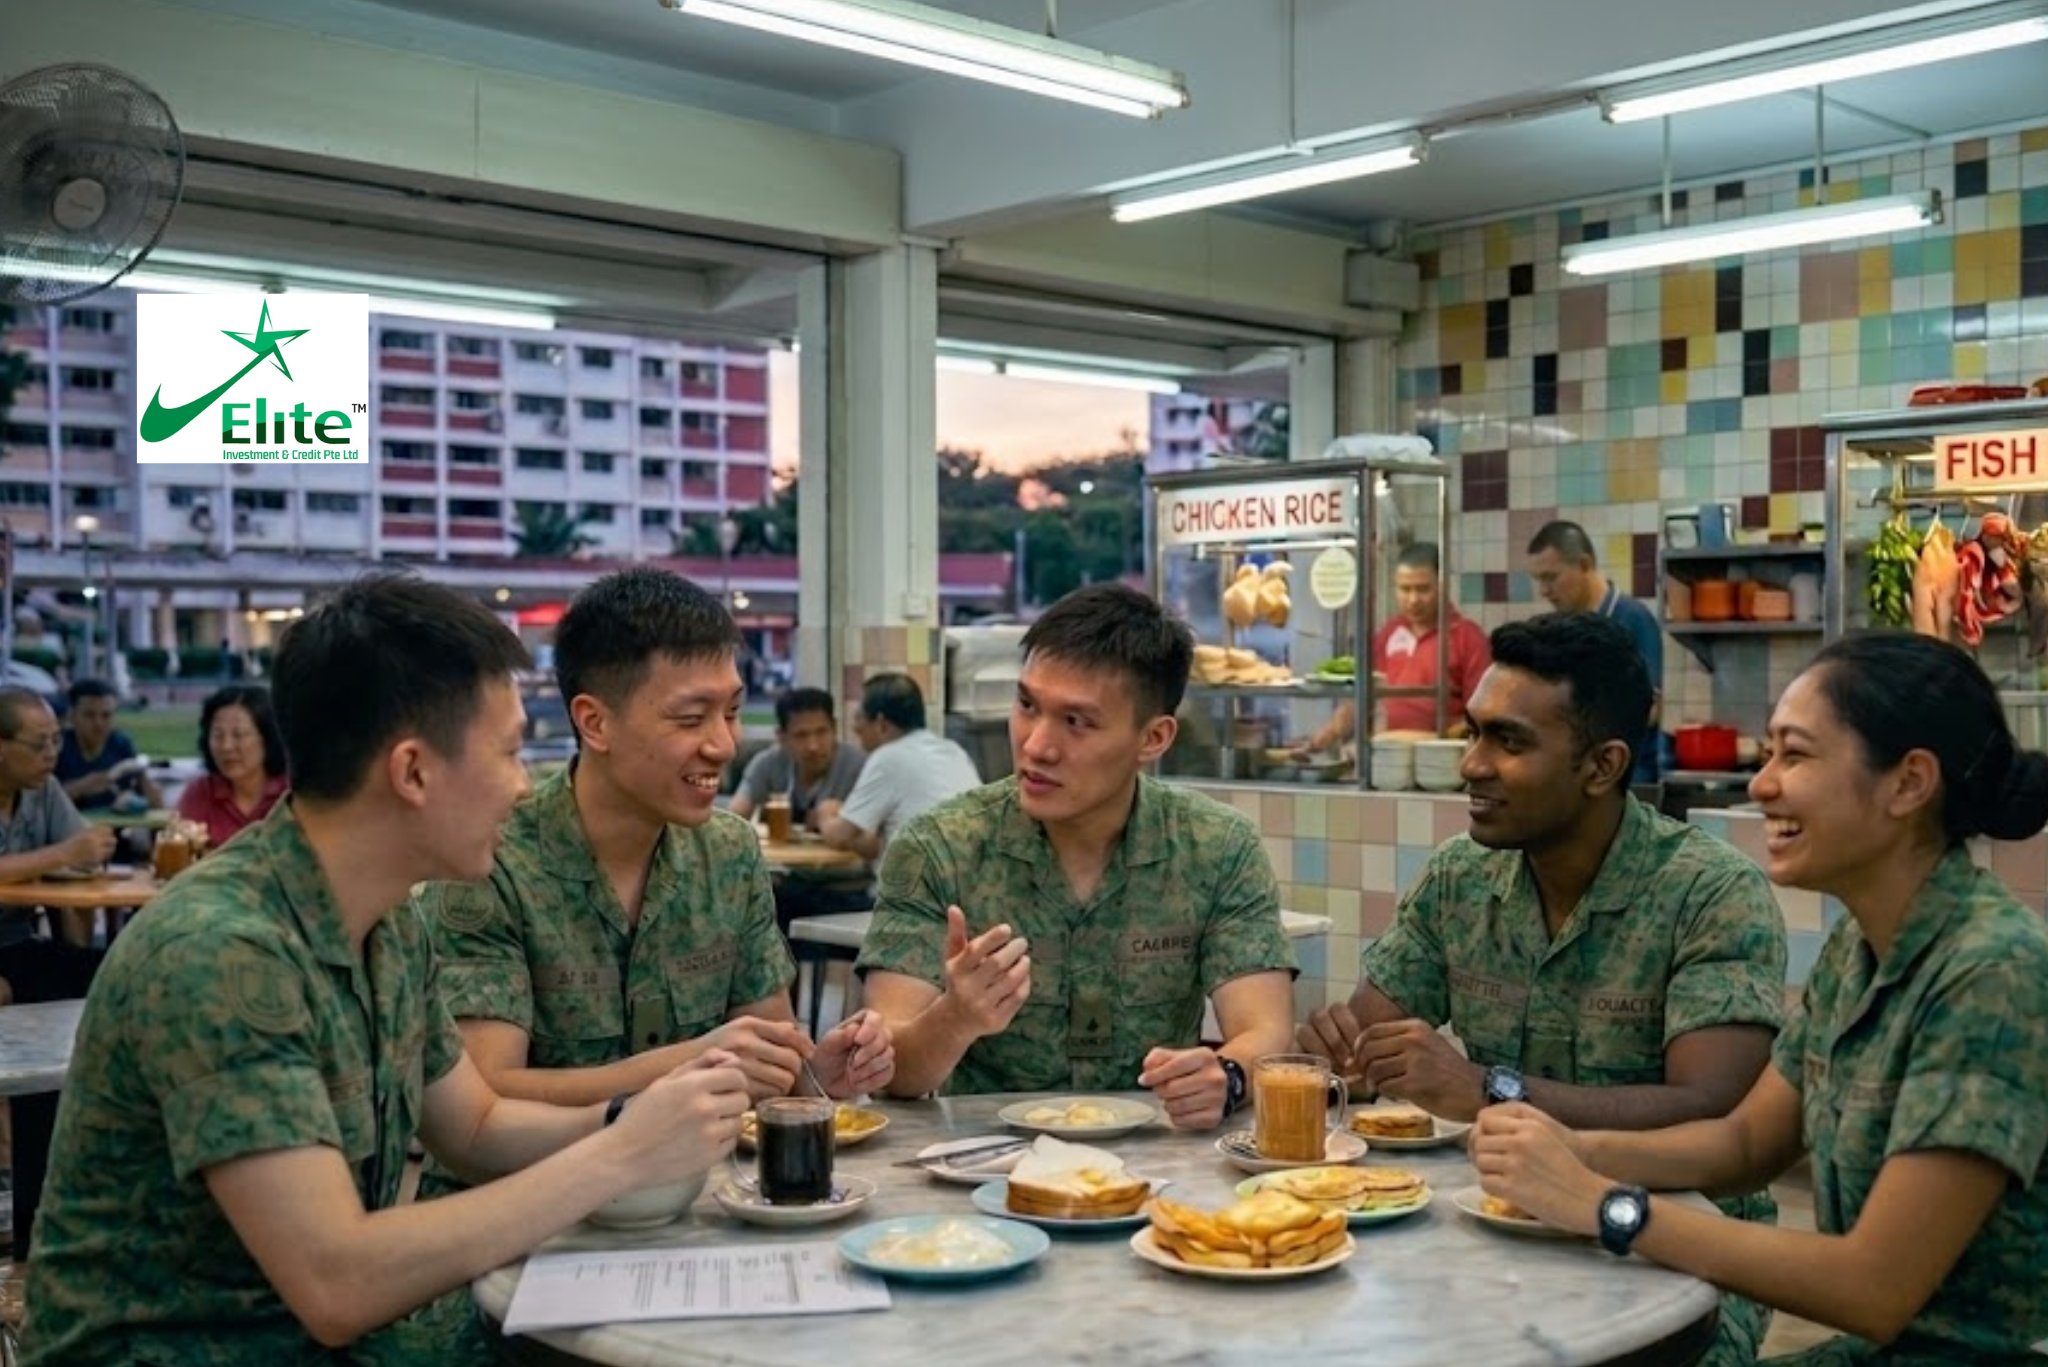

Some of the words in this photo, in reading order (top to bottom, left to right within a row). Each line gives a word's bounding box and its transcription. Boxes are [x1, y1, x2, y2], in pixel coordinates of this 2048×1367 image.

[1947, 436, 2036, 480] FISH
[1172, 494, 1276, 533] CHICKEN
[1285, 490, 1343, 526] RICE
